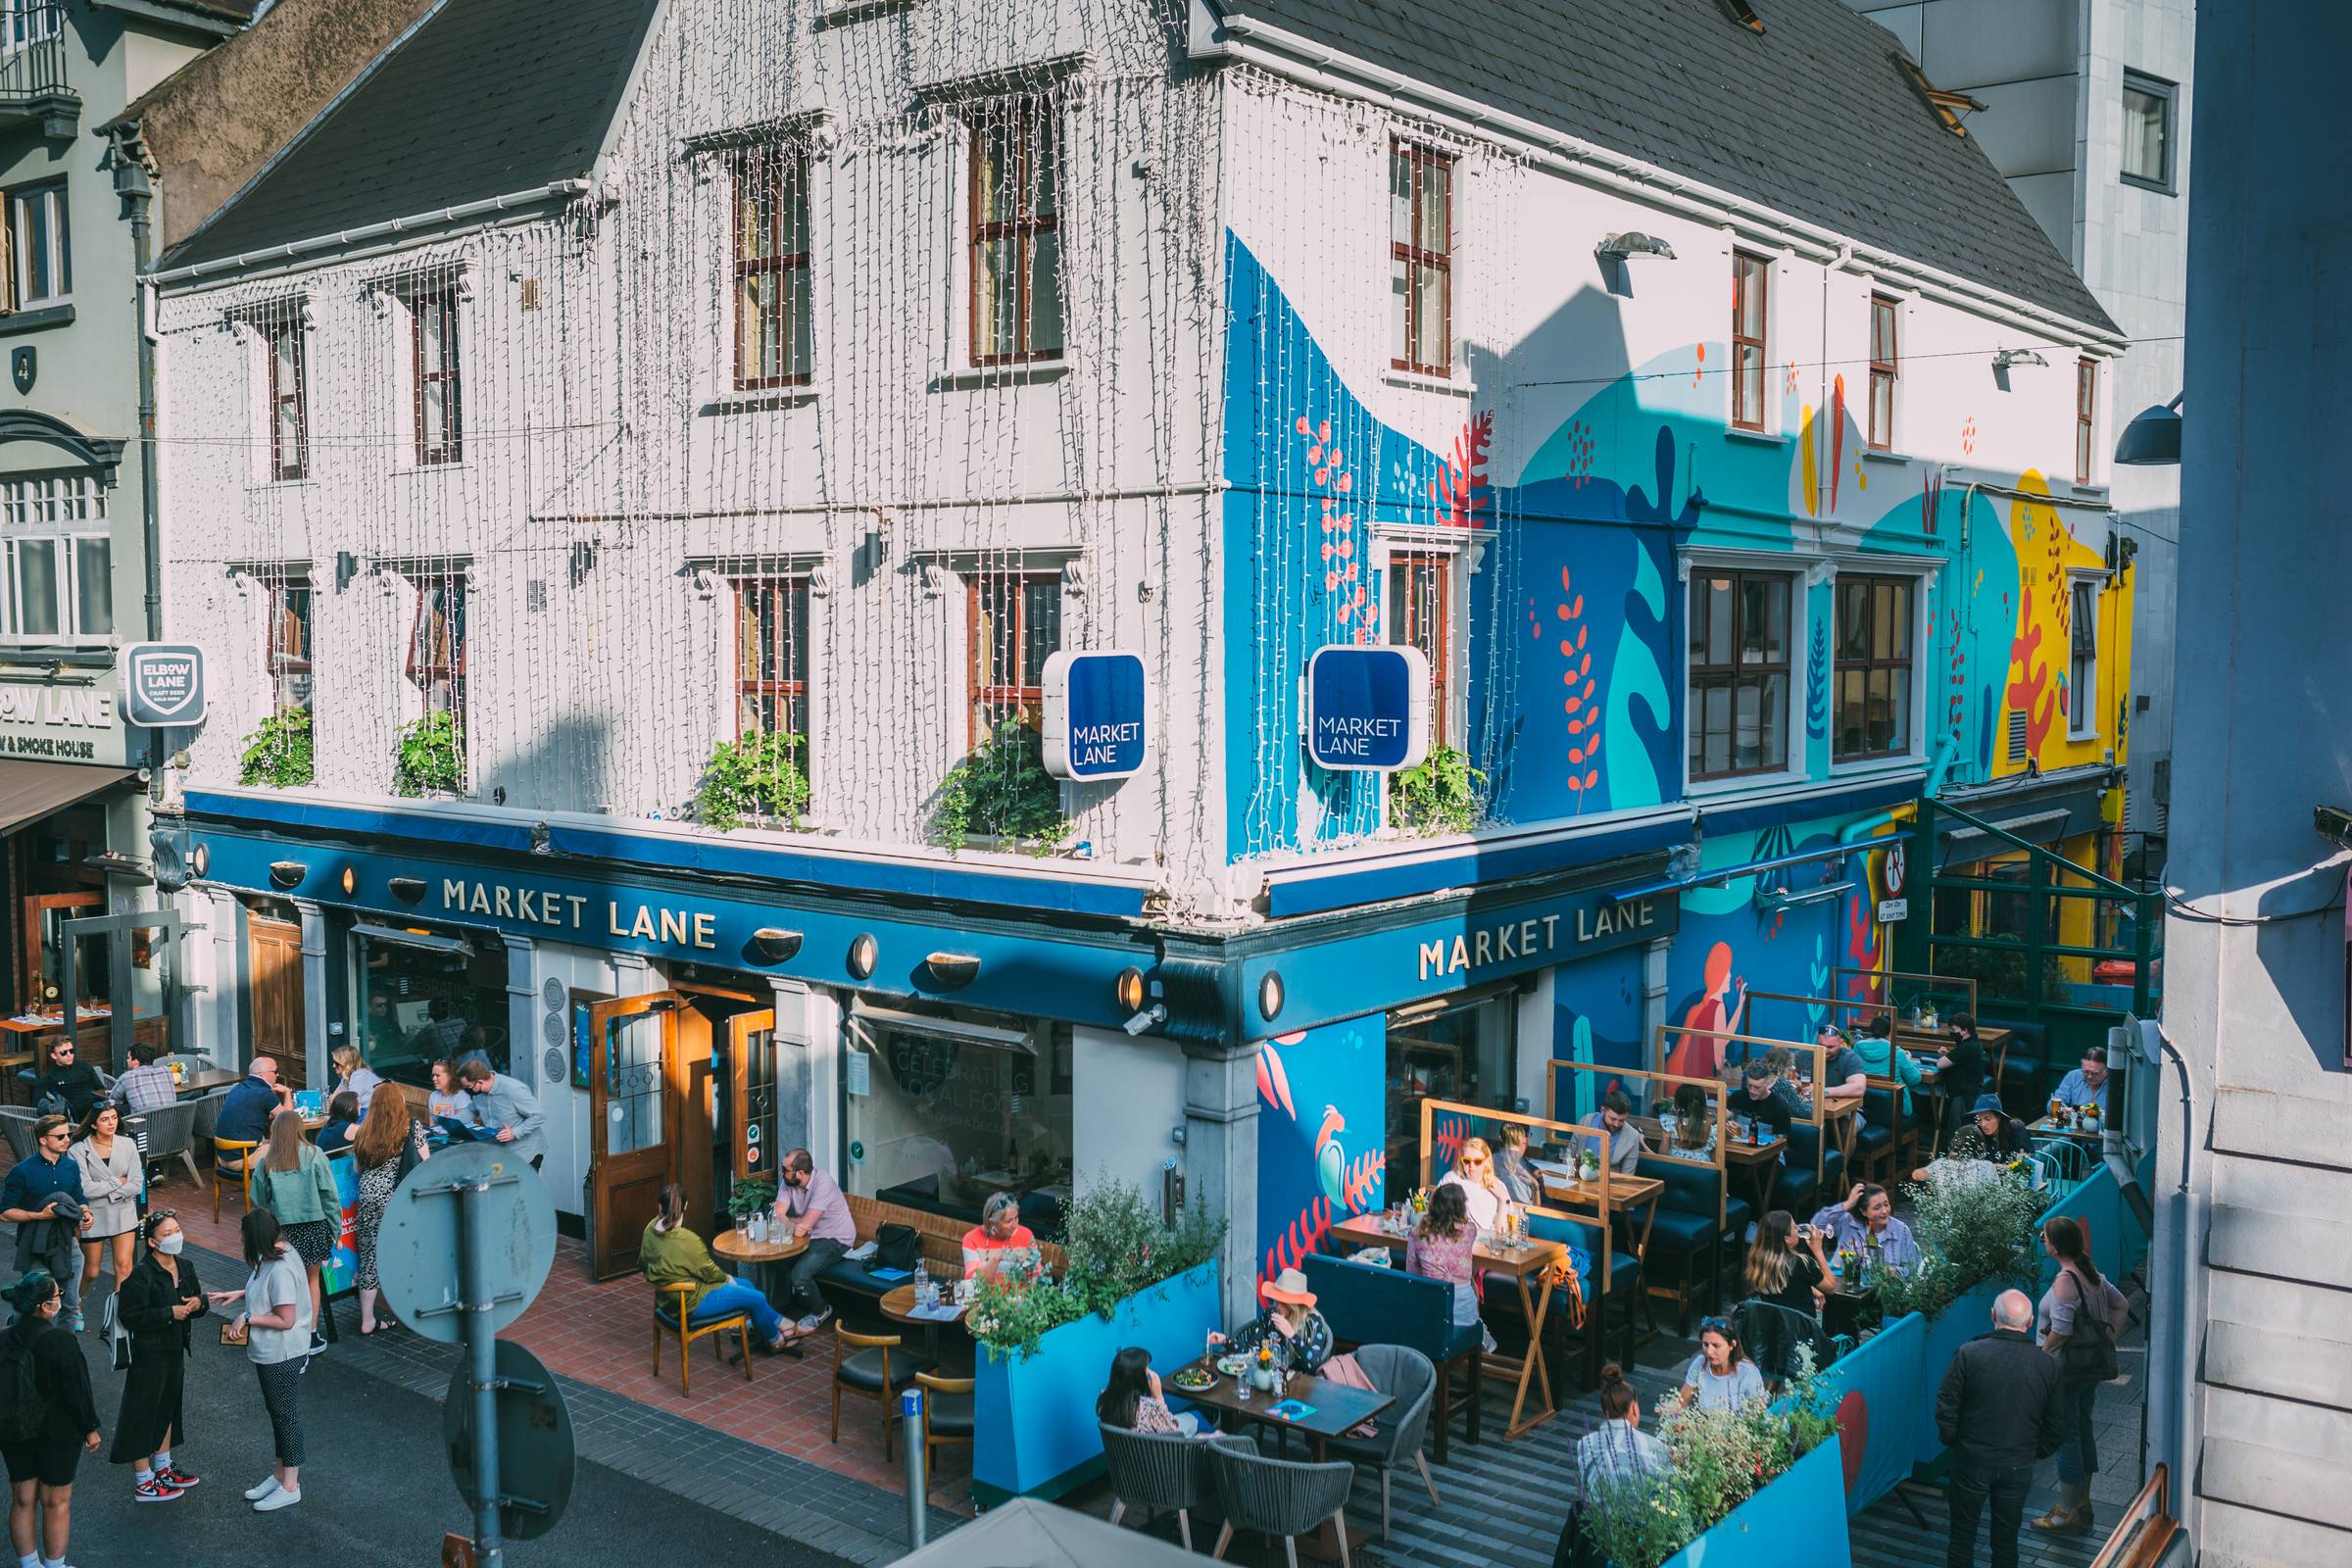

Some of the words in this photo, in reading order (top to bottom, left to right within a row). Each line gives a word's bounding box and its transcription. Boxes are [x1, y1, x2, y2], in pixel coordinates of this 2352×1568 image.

[18, 358, 29, 380] 4
[143, 663, 190, 675] ELBOW
[148, 676, 186, 688] LANE
[0, 687, 40, 724] OW
[44, 689, 112, 730] LANE
[1073, 722, 1141, 745] MARKET
[1319, 715, 1401, 737] MARKET
[8, 736, 16, 753] &
[17, 737, 54, 756] SMOKE
[56, 740, 94, 759] HOUSE
[1073, 744, 1117, 765] LANE
[1318, 736, 1370, 756] LANE
[443, 878, 588, 929] MARKET
[609, 901, 716, 950] LANE
[1418, 913, 1560, 981] MARKET
[1577, 900, 1654, 942] LANE
[899, 1075, 965, 1108] LOCAL
